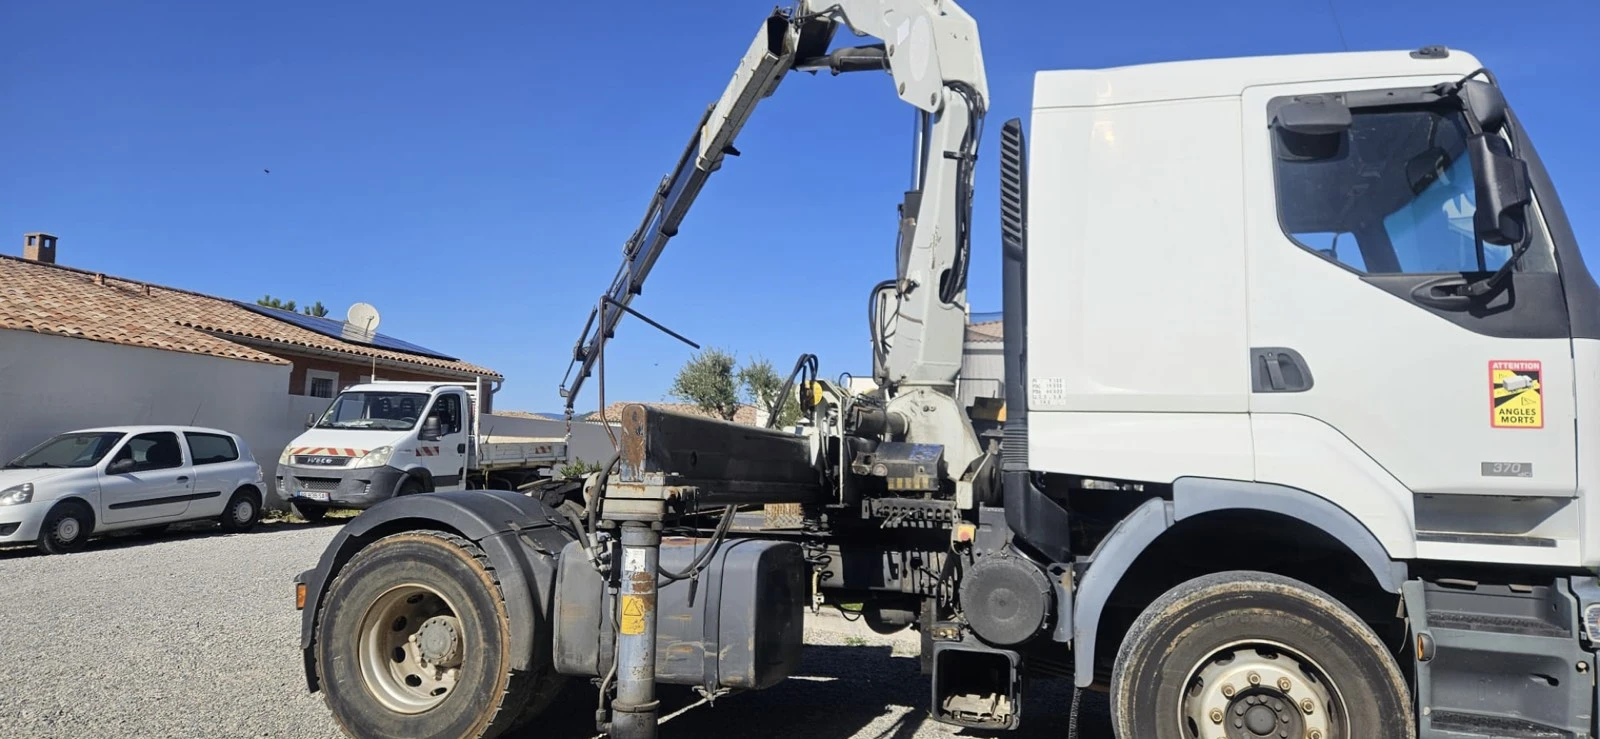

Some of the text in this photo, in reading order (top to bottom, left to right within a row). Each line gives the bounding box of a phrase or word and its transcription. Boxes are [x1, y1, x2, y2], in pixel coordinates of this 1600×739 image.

[1493, 362, 1540, 371] ATTENTION
[1499, 408, 1536, 416] ANGLES
[1501, 416, 1535, 424] MORTS
[1493, 463, 1521, 473] 370
